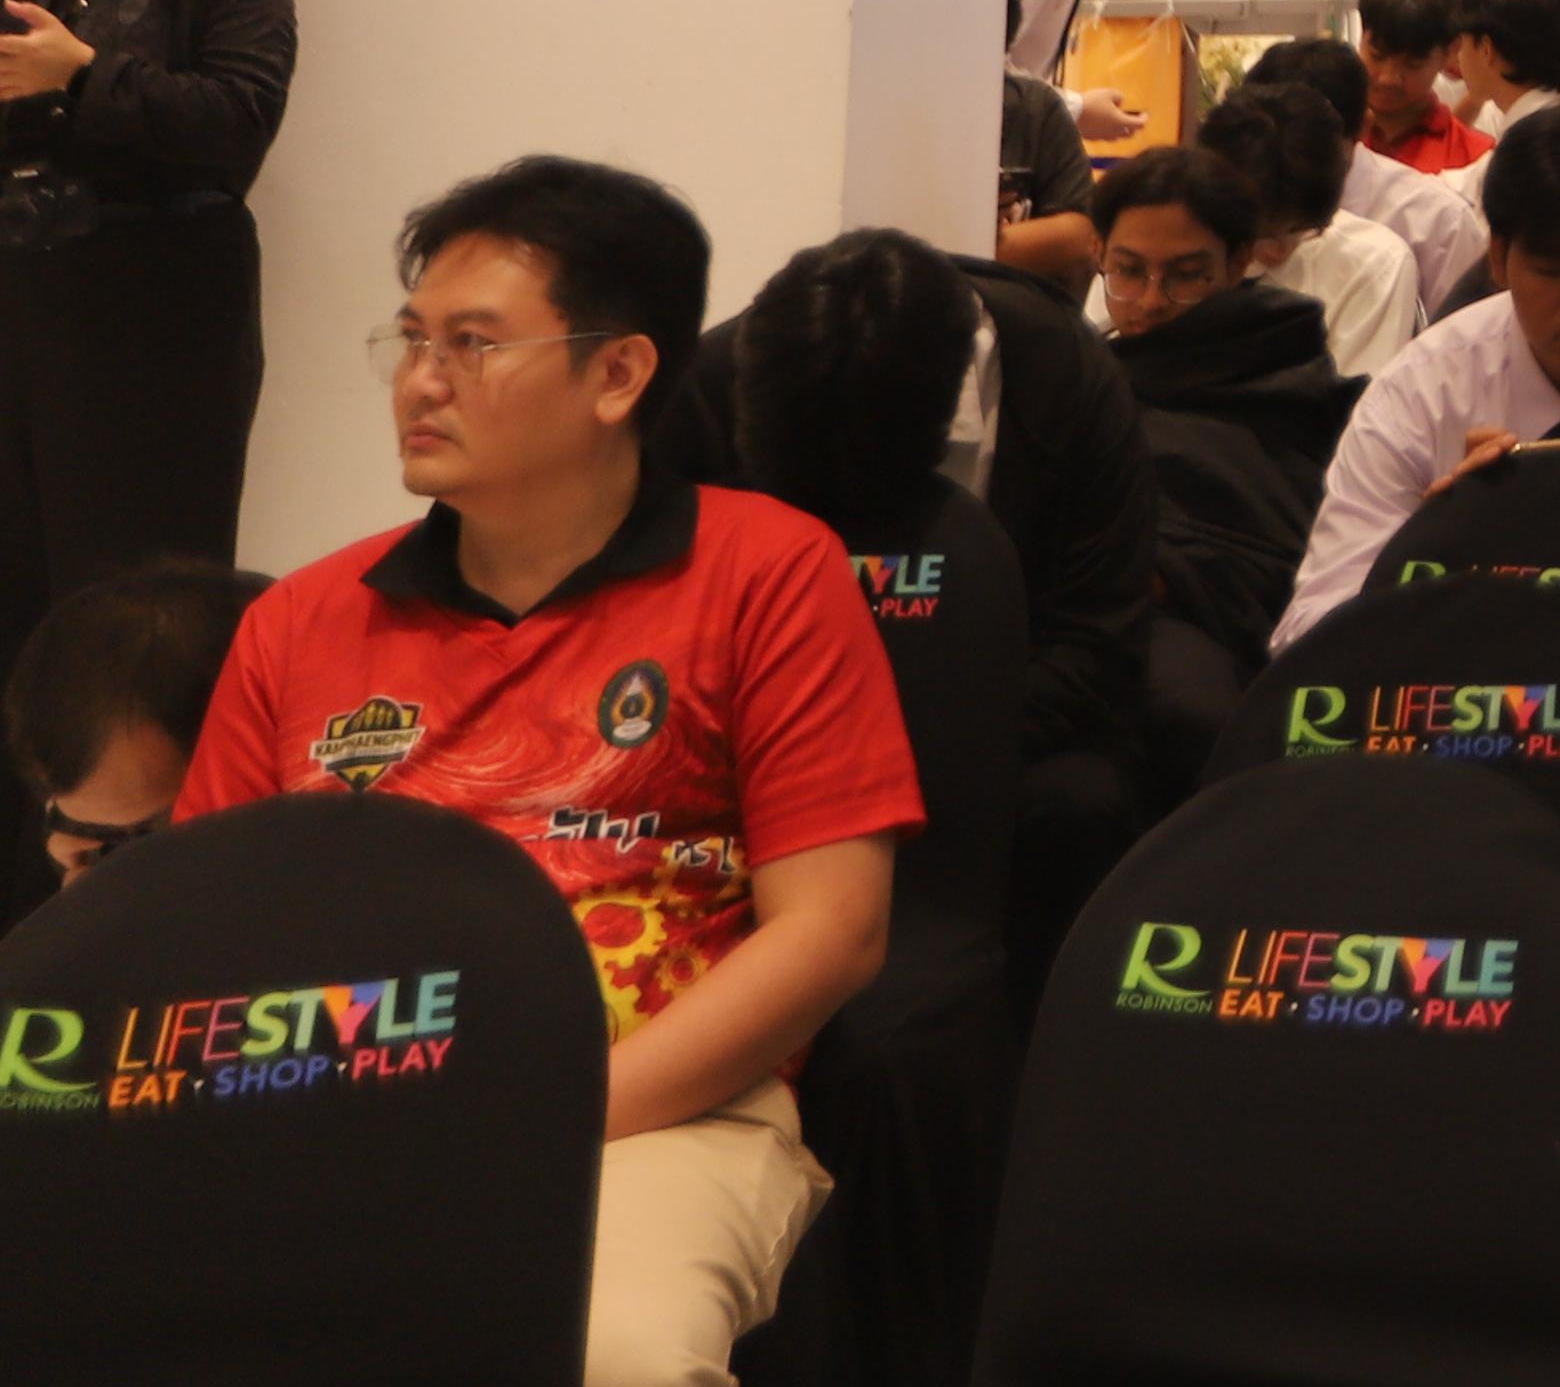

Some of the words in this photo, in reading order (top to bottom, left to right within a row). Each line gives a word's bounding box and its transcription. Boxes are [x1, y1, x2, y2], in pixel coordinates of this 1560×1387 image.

[880, 597, 939, 617] PLAY
[1287, 685, 1360, 747] R
[1436, 734, 1513, 758] SHOP
[1112, 922, 1212, 996] R
[1227, 928, 1519, 995] LIFESTYLE
[0, 1007, 98, 1093] R
[116, 970, 461, 1072] LIFESTYLE
[1115, 991, 1214, 1015] ROBINSON
[1218, 988, 1285, 1020] EAT
[1304, 994, 1404, 1026] SHOP
[1422, 998, 1513, 1028] PLAY
[0, 1091, 99, 1110] OBINSON
[107, 1070, 188, 1108] EAT
[212, 1054, 329, 1097] SHOP
[352, 1037, 455, 1081] PLAY
